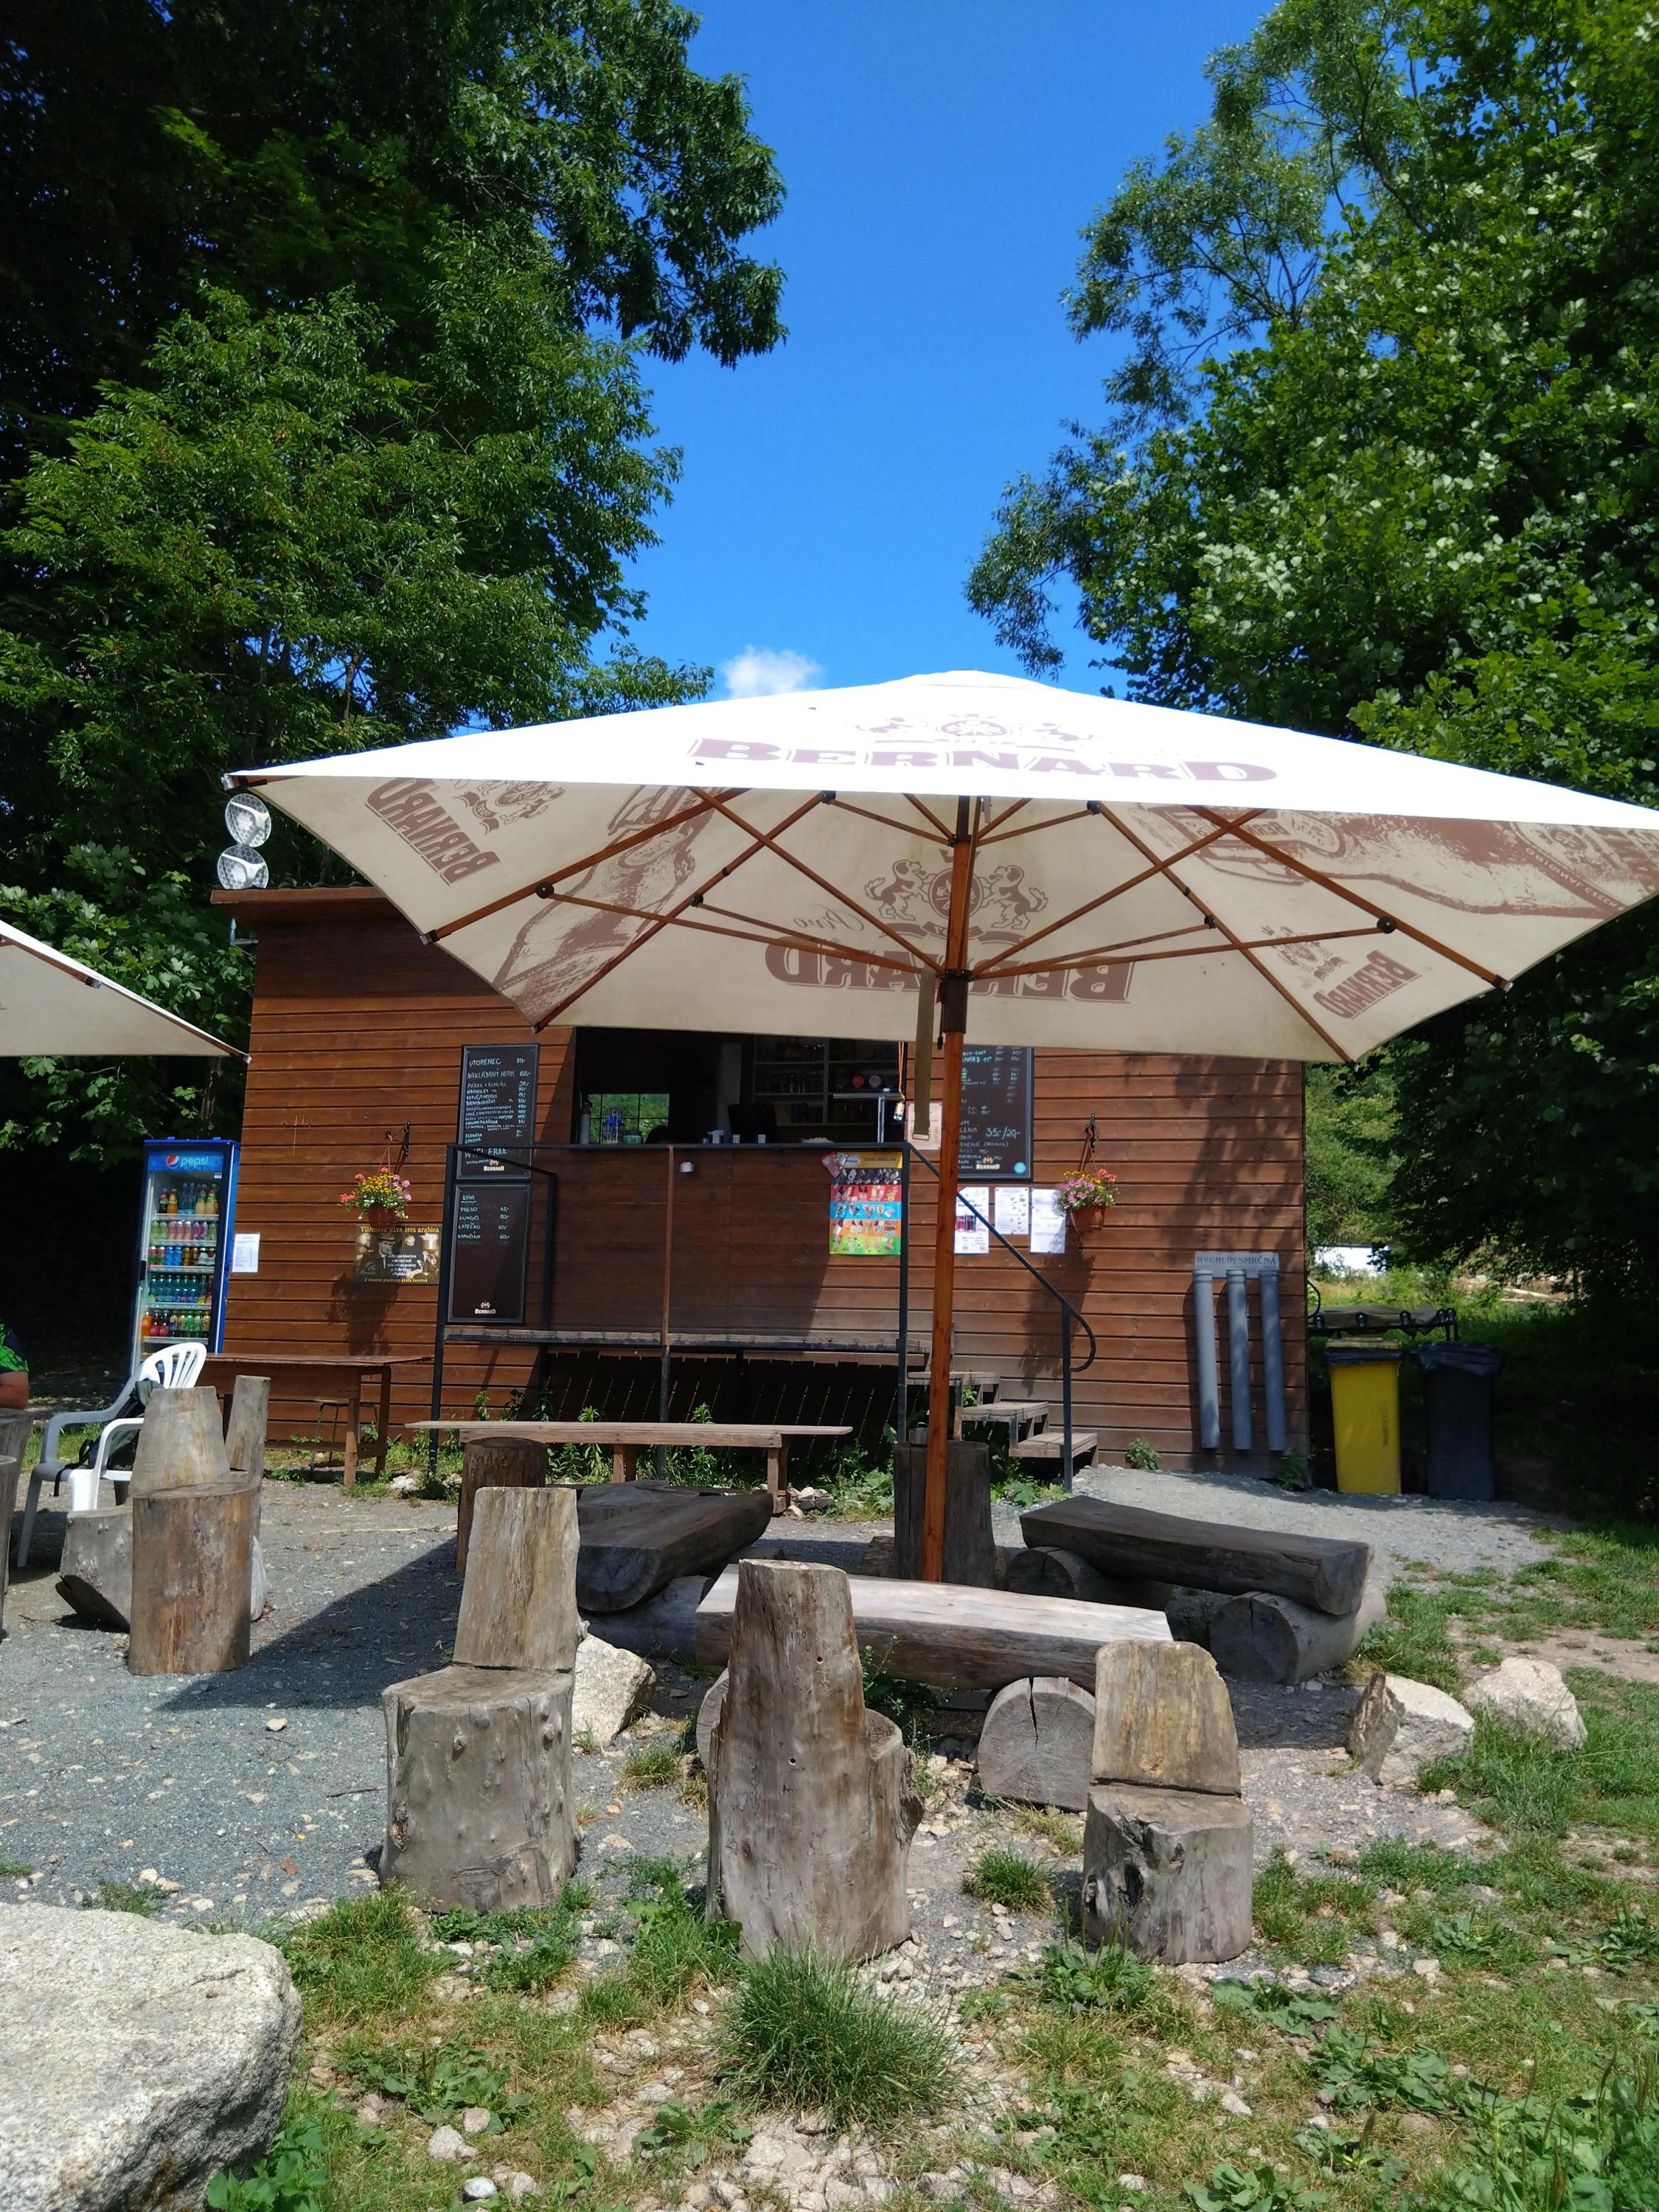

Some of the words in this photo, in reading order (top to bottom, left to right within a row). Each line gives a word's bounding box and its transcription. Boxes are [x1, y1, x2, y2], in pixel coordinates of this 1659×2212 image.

[686, 737, 1277, 782] BERNARD
[469, 1058, 501, 1067] UTOPENEC
[180, 1155, 209, 1168] pepsi
[417, 1225, 439, 1234] arabica
[1197, 1255, 1236, 1264] RYCHLÍK
[1239, 1255, 1276, 1265] SMRČNÁ
